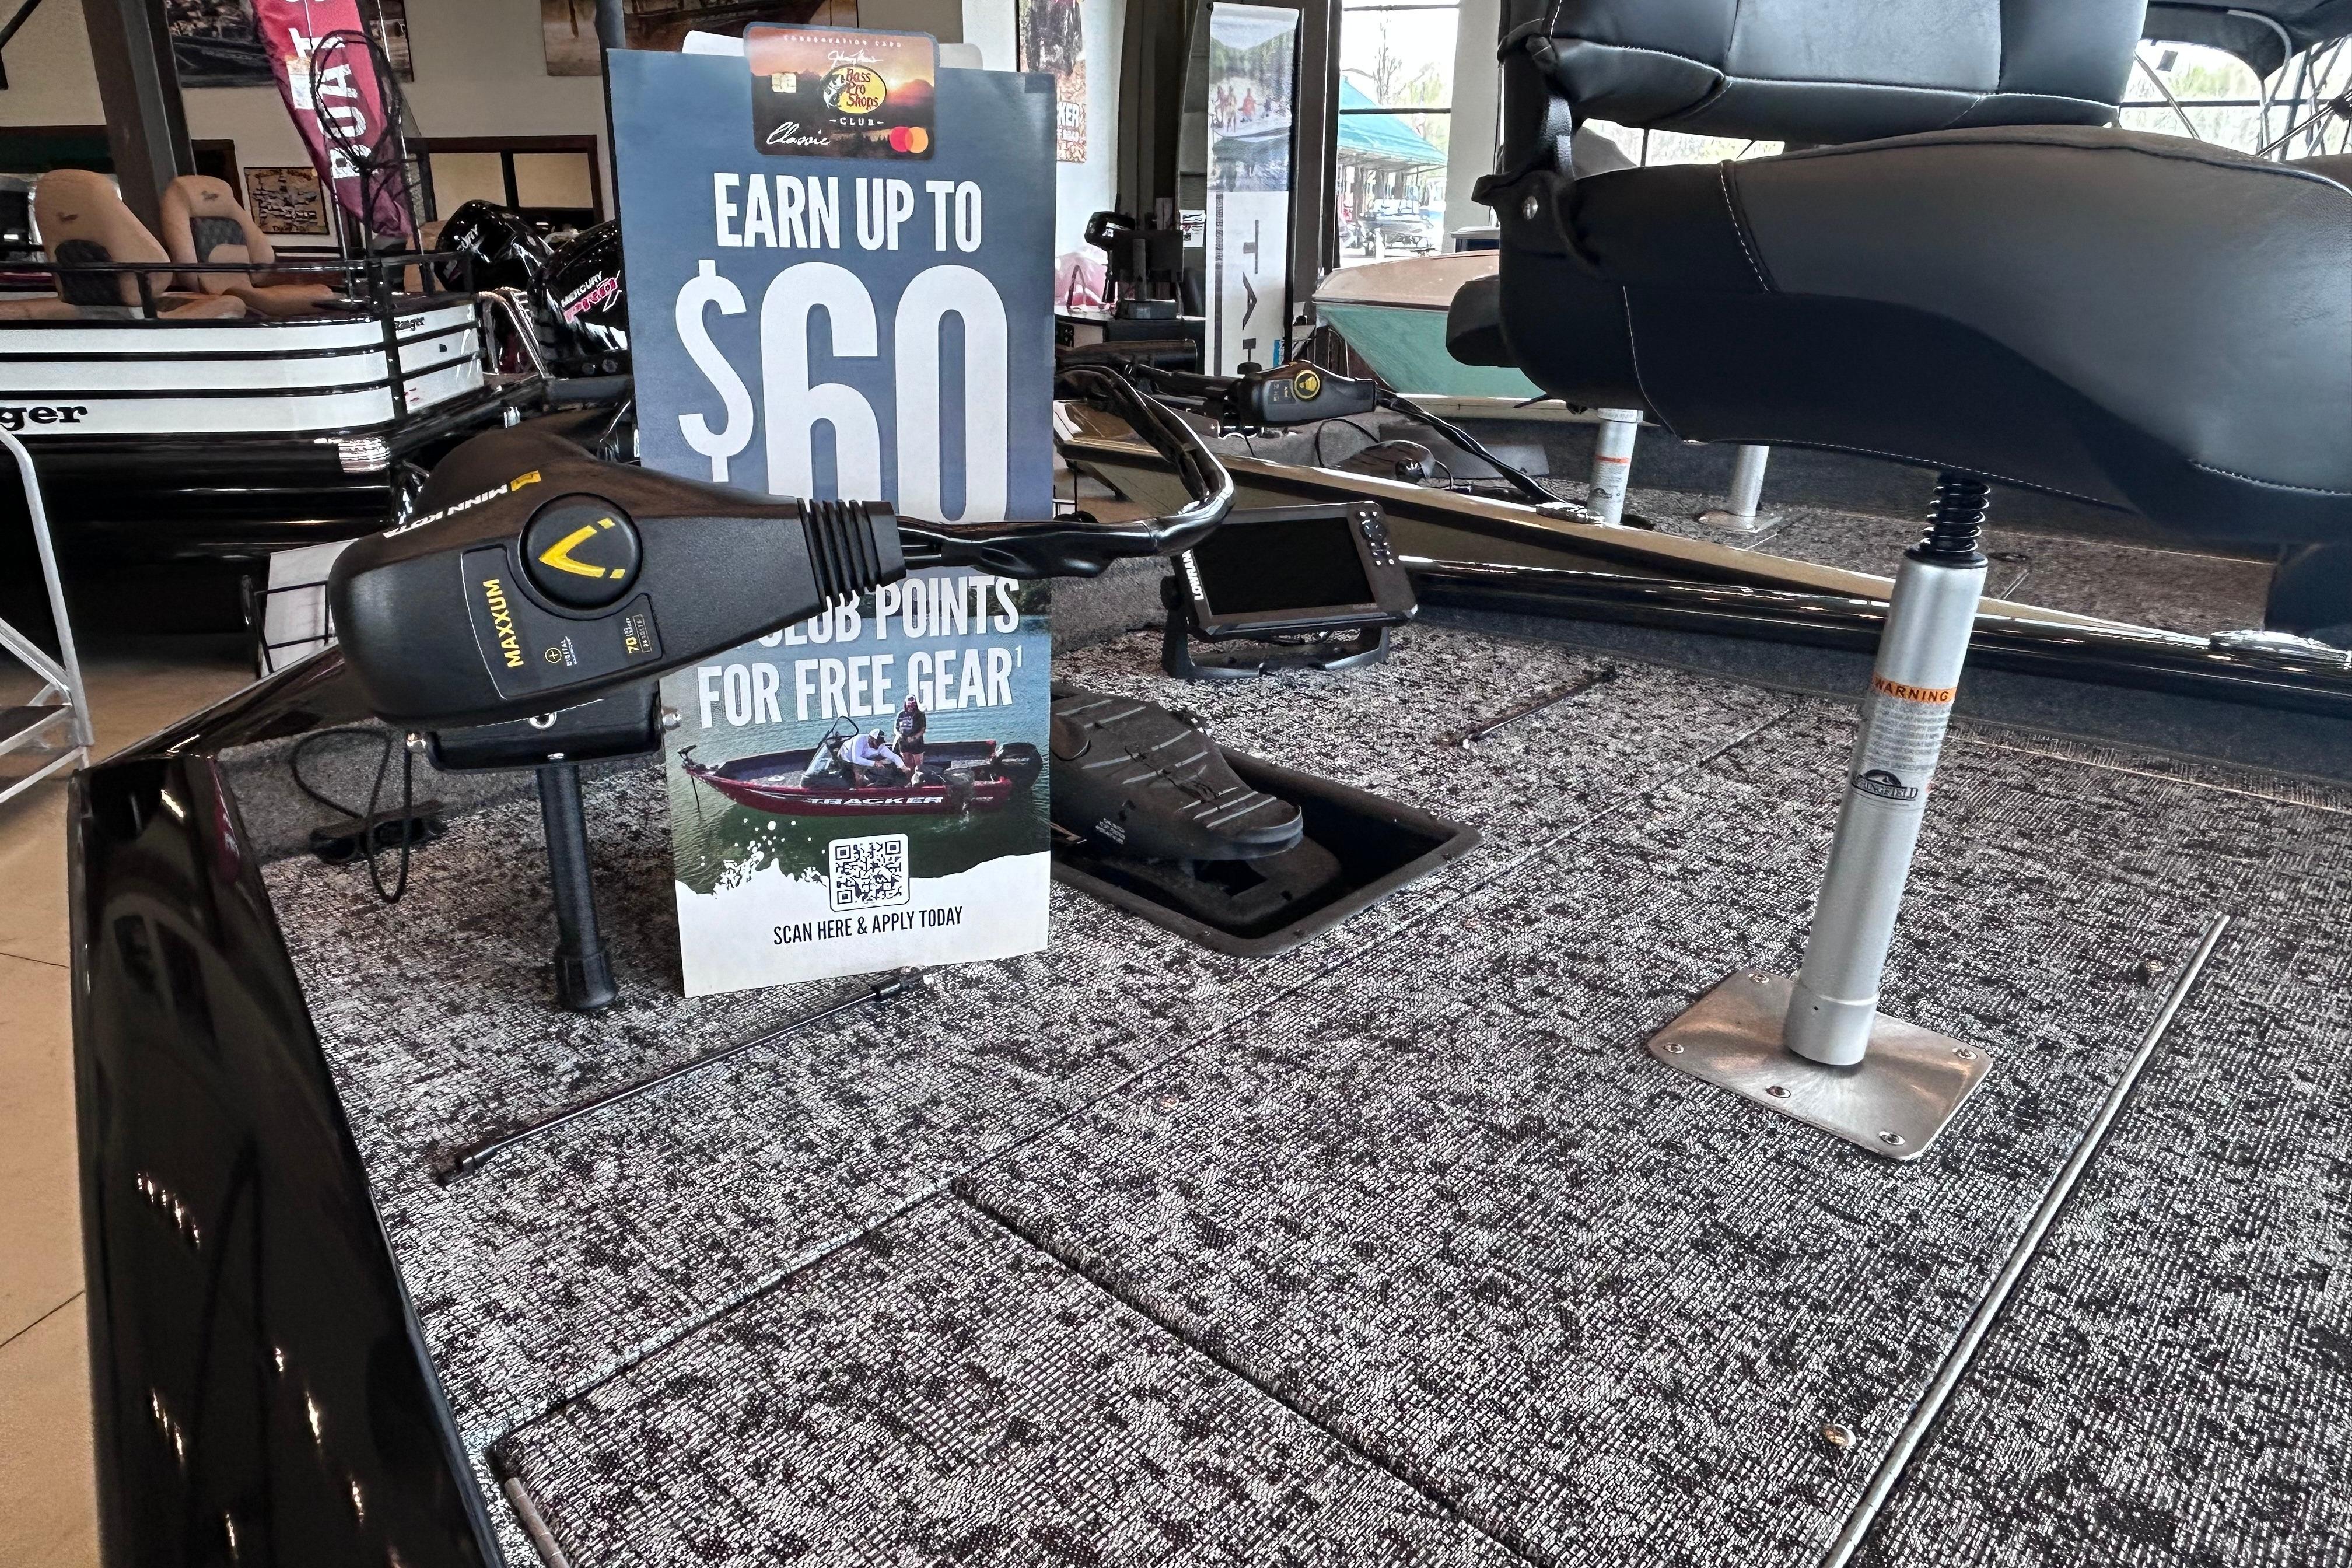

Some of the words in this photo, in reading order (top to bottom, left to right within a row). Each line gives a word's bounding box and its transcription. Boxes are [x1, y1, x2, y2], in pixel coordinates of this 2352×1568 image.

[846, 68, 872, 83] Bass
[846, 83, 866, 94] Pro
[846, 93, 879, 111] Shops
[766, 121, 831, 146] Classic
[713, 173, 841, 249] EARN
[856, 177, 915, 251] UP
[926, 180, 982, 253] TO
[561, 270, 603, 307] MERCURY
[675, 260, 1007, 522] $60
[447, 484, 508, 516] MINN
[383, 511, 443, 538] KOTA
[876, 576, 1020, 640] POINTS
[482, 579, 524, 667] MAXXUM
[625, 636, 639, 654] 70
[697, 663, 783, 729] FOR
[795, 654, 895, 721] FREE
[1875, 678, 1949, 701] WARNING
[810, 796, 944, 805] TRACKER
[774, 922, 813, 945] SCAN
[817, 918, 853, 940] HERE
[857, 916, 867, 935] &
[872, 911, 915, 934] APPLY
[919, 906, 963, 928] TODAY
